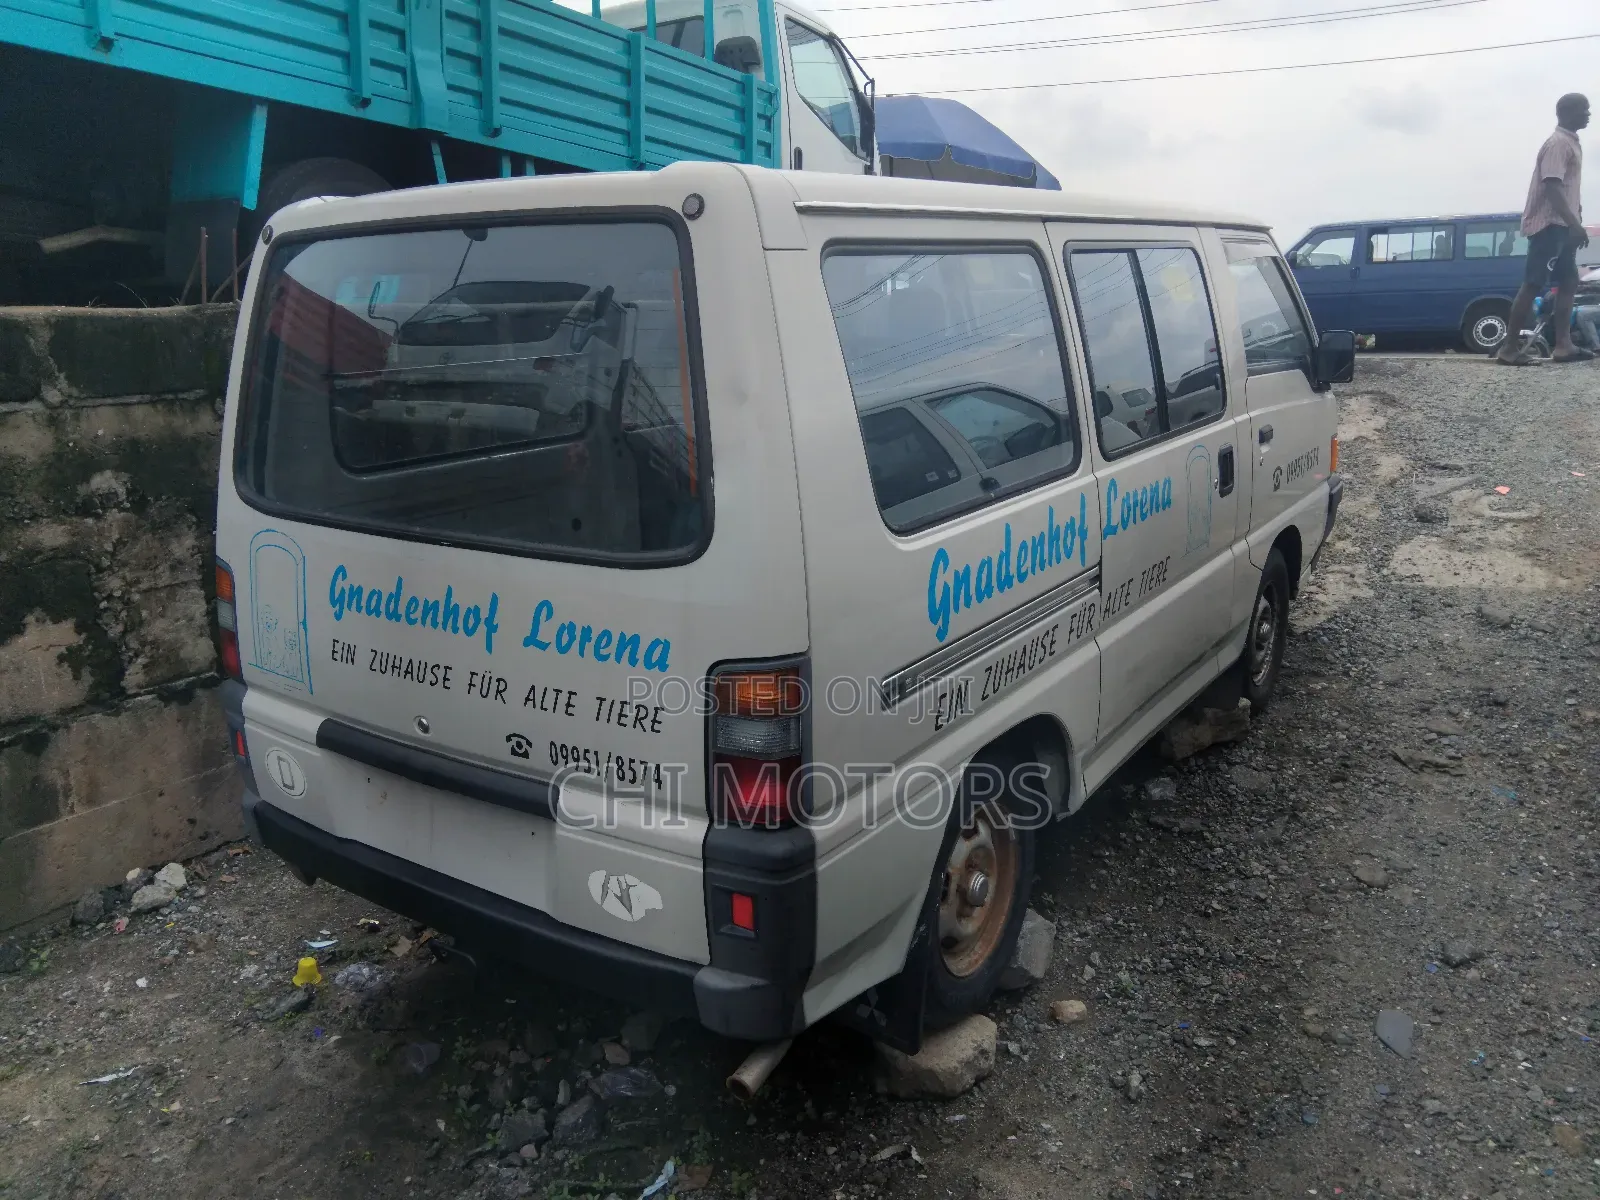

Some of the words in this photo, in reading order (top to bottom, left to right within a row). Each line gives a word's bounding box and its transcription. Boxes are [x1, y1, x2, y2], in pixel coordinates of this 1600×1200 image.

[927, 491, 1089, 643] Gnadenhof
[1102, 476, 1173, 541] Lorena
[328, 564, 499, 655] Gnadenhof
[522, 599, 672, 673] Lorena
[934, 679, 969, 732] EIN
[980, 623, 1060, 702] ZUHAUSE
[1067, 602, 1096, 644] FÜR
[1102, 578, 1134, 622] ALTE
[1138, 555, 1171, 598] TIERE
[330, 638, 357, 666] EIN
[369, 648, 453, 690] ZUHAUSE
[467, 670, 508, 705] FÜR
[523, 684, 578, 718] ALTE
[595, 696, 665, 734] TIERE
[549, 740, 663, 791] 09951/8574
